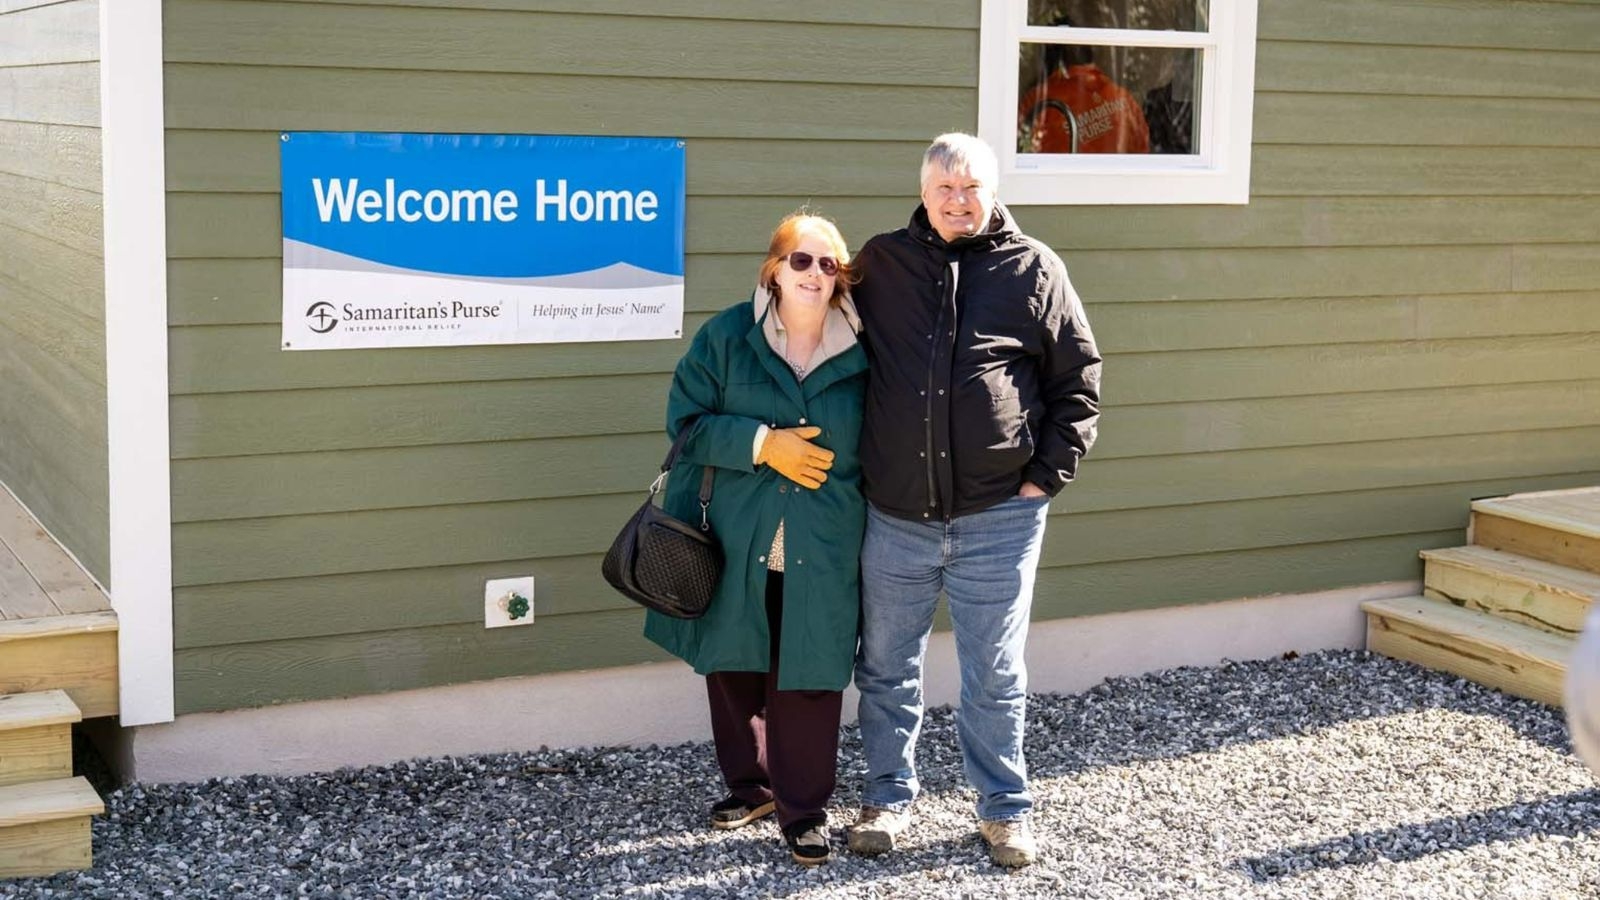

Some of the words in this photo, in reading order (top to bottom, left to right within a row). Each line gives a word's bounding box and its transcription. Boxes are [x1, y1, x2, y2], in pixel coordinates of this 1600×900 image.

[1078, 116, 1113, 143] PURSE
[311, 178, 519, 223] Welcome
[535, 179, 659, 222] Home
[342, 301, 448, 321] Samaritan's
[451, 301, 501, 319] Purse
[532, 303, 578, 320] Helping
[581, 303, 593, 317] in
[595, 302, 629, 318] Jesus'
[630, 302, 664, 315] Name
[427, 323, 462, 331] RELIEF
